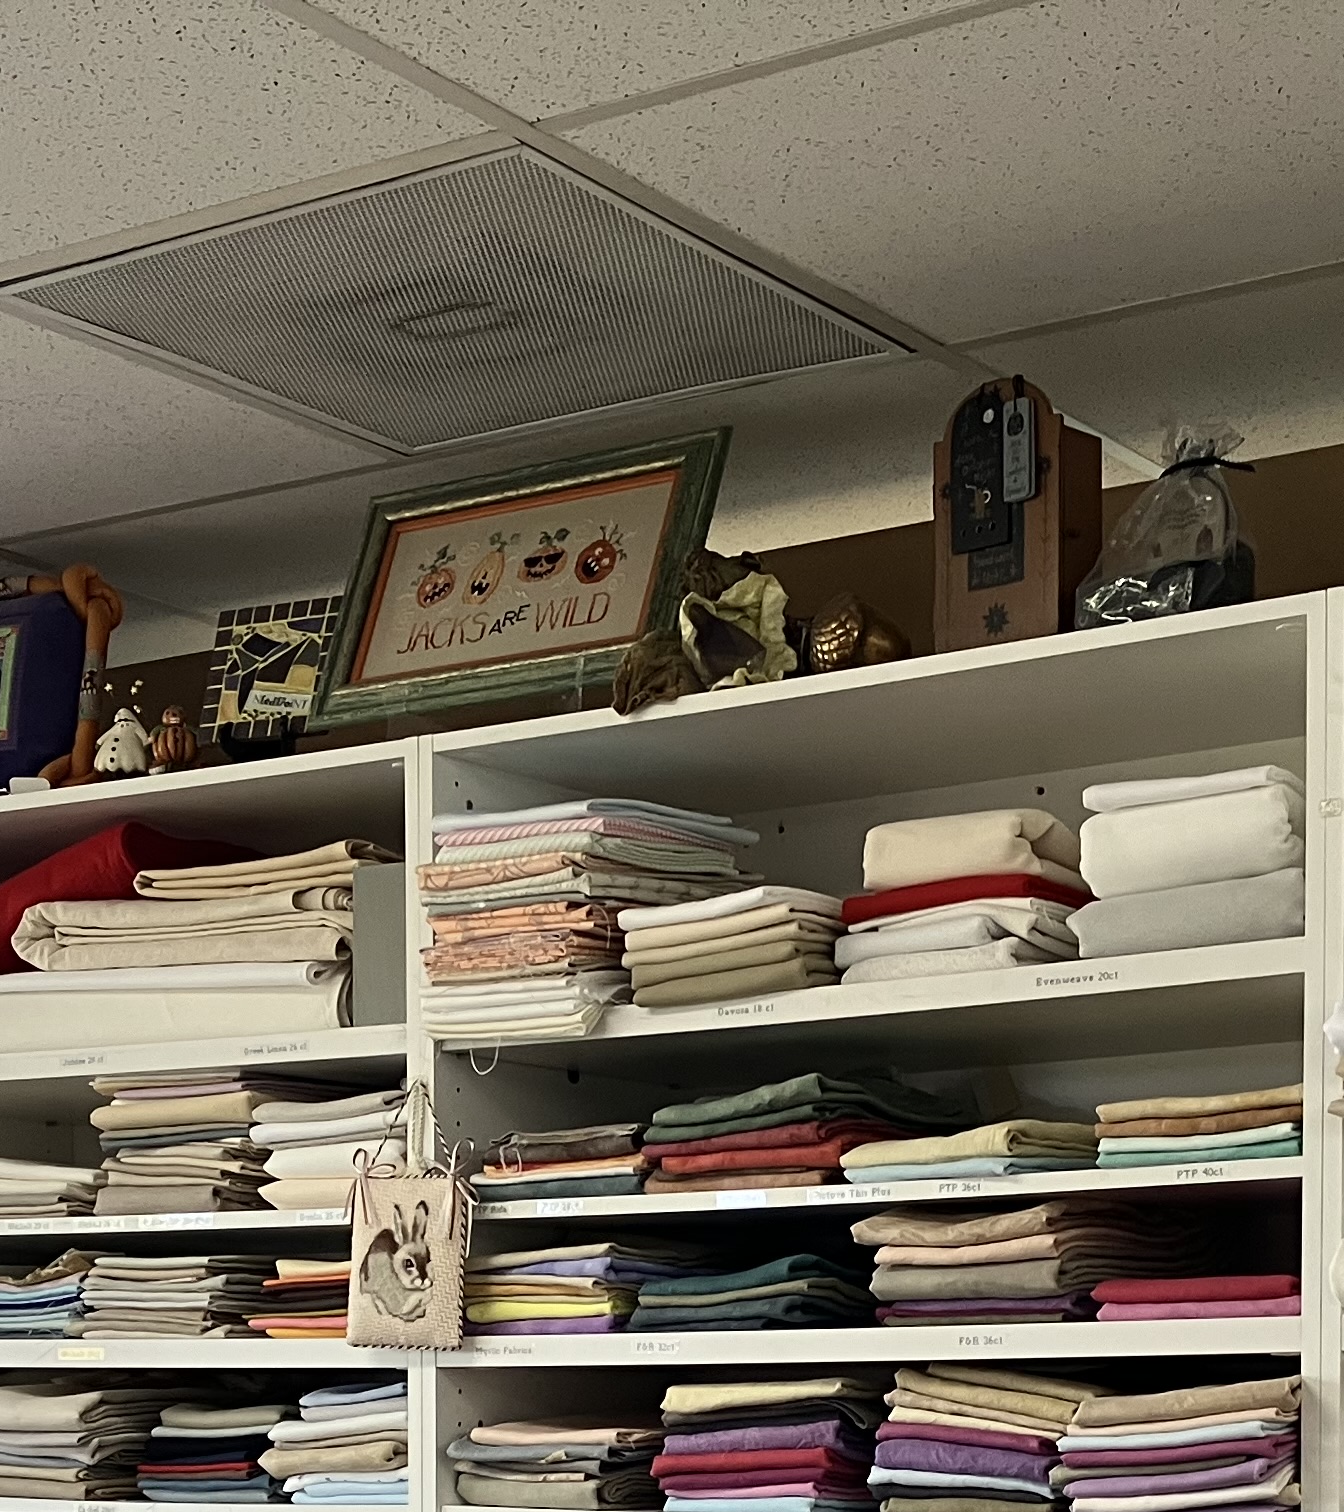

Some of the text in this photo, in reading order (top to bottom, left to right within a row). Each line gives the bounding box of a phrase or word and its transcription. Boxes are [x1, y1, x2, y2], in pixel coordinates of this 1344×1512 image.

[397, 591, 611, 655] JACKS ARE WILD
[1036, 971, 1119, 987] Evenweave 20ct
[1176, 1167, 1224, 1179] PTP 40ct
[938, 1183, 957, 1193] PTP
